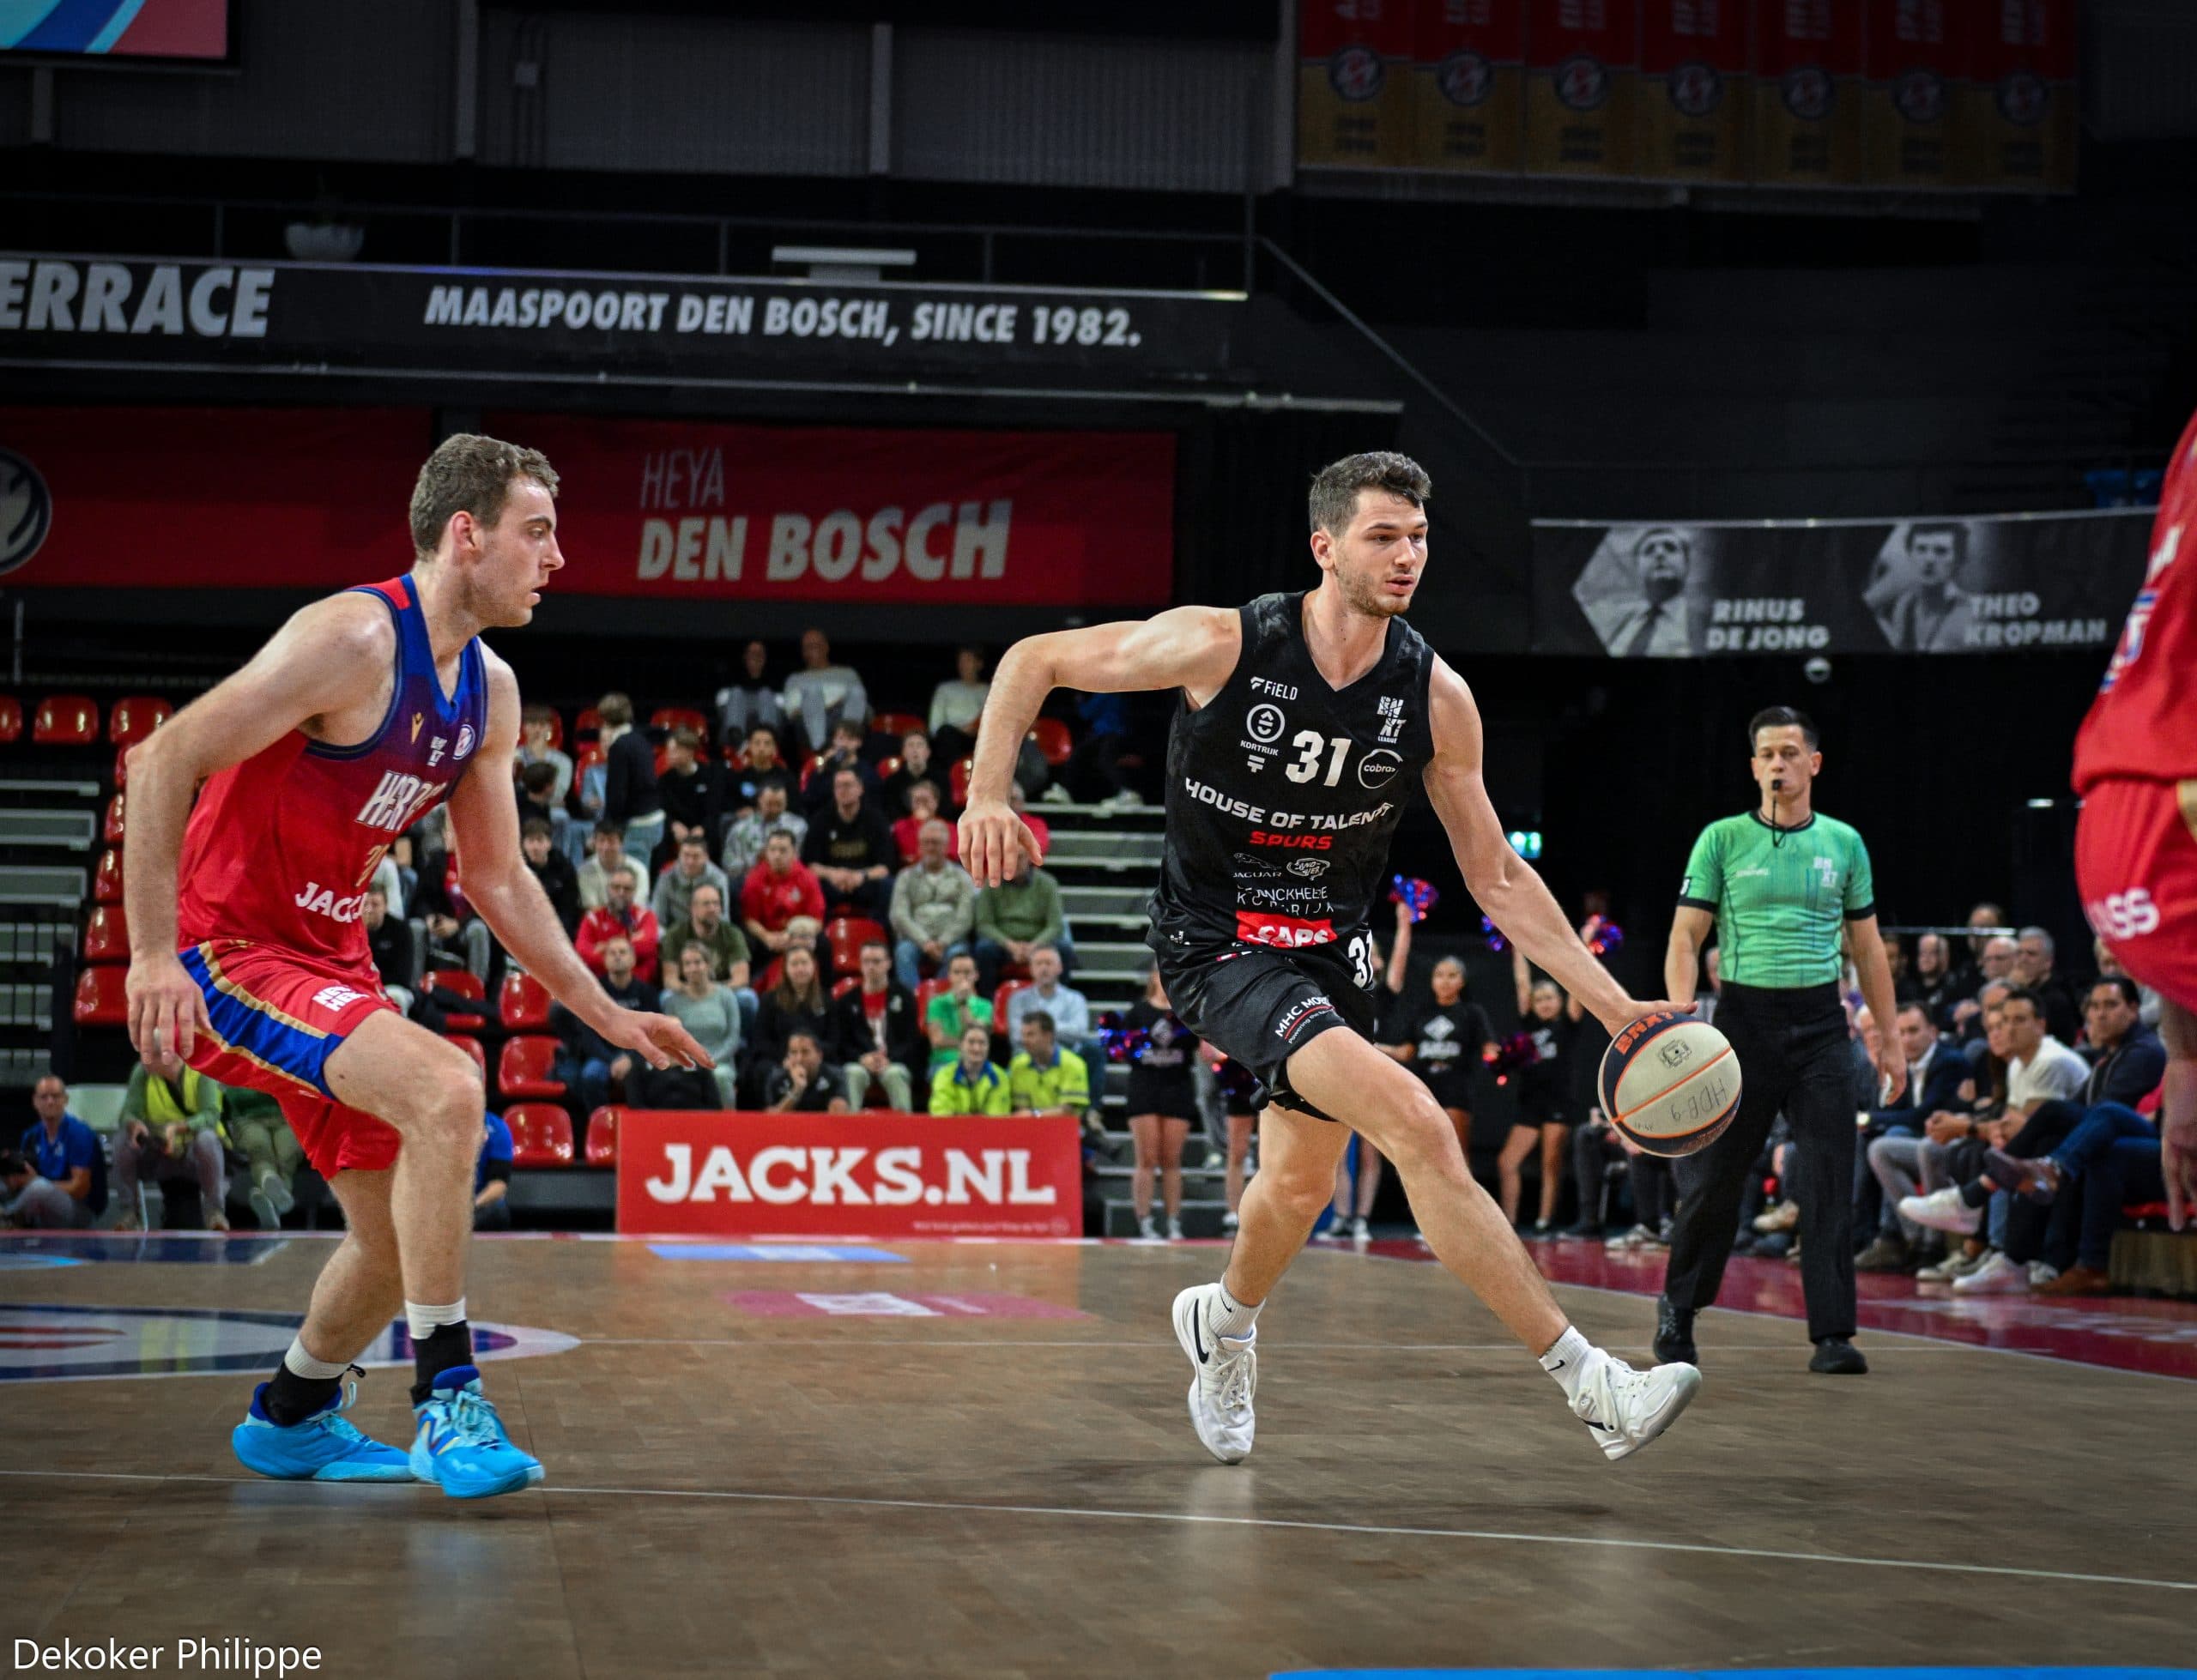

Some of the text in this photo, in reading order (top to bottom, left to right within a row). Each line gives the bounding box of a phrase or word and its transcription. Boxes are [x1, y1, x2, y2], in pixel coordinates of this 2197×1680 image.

[0, 260, 275, 337] ERRACE
[424, 285, 1141, 347] MAASPOORT DEN BOSCH, SINCE 1982.
[640, 446, 725, 509] HEYA
[637, 499, 1013, 582] DEN BOSCH
[1713, 598, 1805, 623] RINUS
[1970, 592, 2040, 618] THEO
[1706, 624, 1830, 650] DE JONG
[1964, 619, 2107, 646] KROPMAN
[1240, 740, 1280, 756] KORTRIJK
[1286, 729, 1353, 788] 31
[1185, 777, 1394, 830] HOUSE OF TALENT
[1250, 831, 1333, 849] SPURS
[1274, 1006, 1303, 1037] MHC
[645, 1143, 1056, 1206] JACKS.NL
